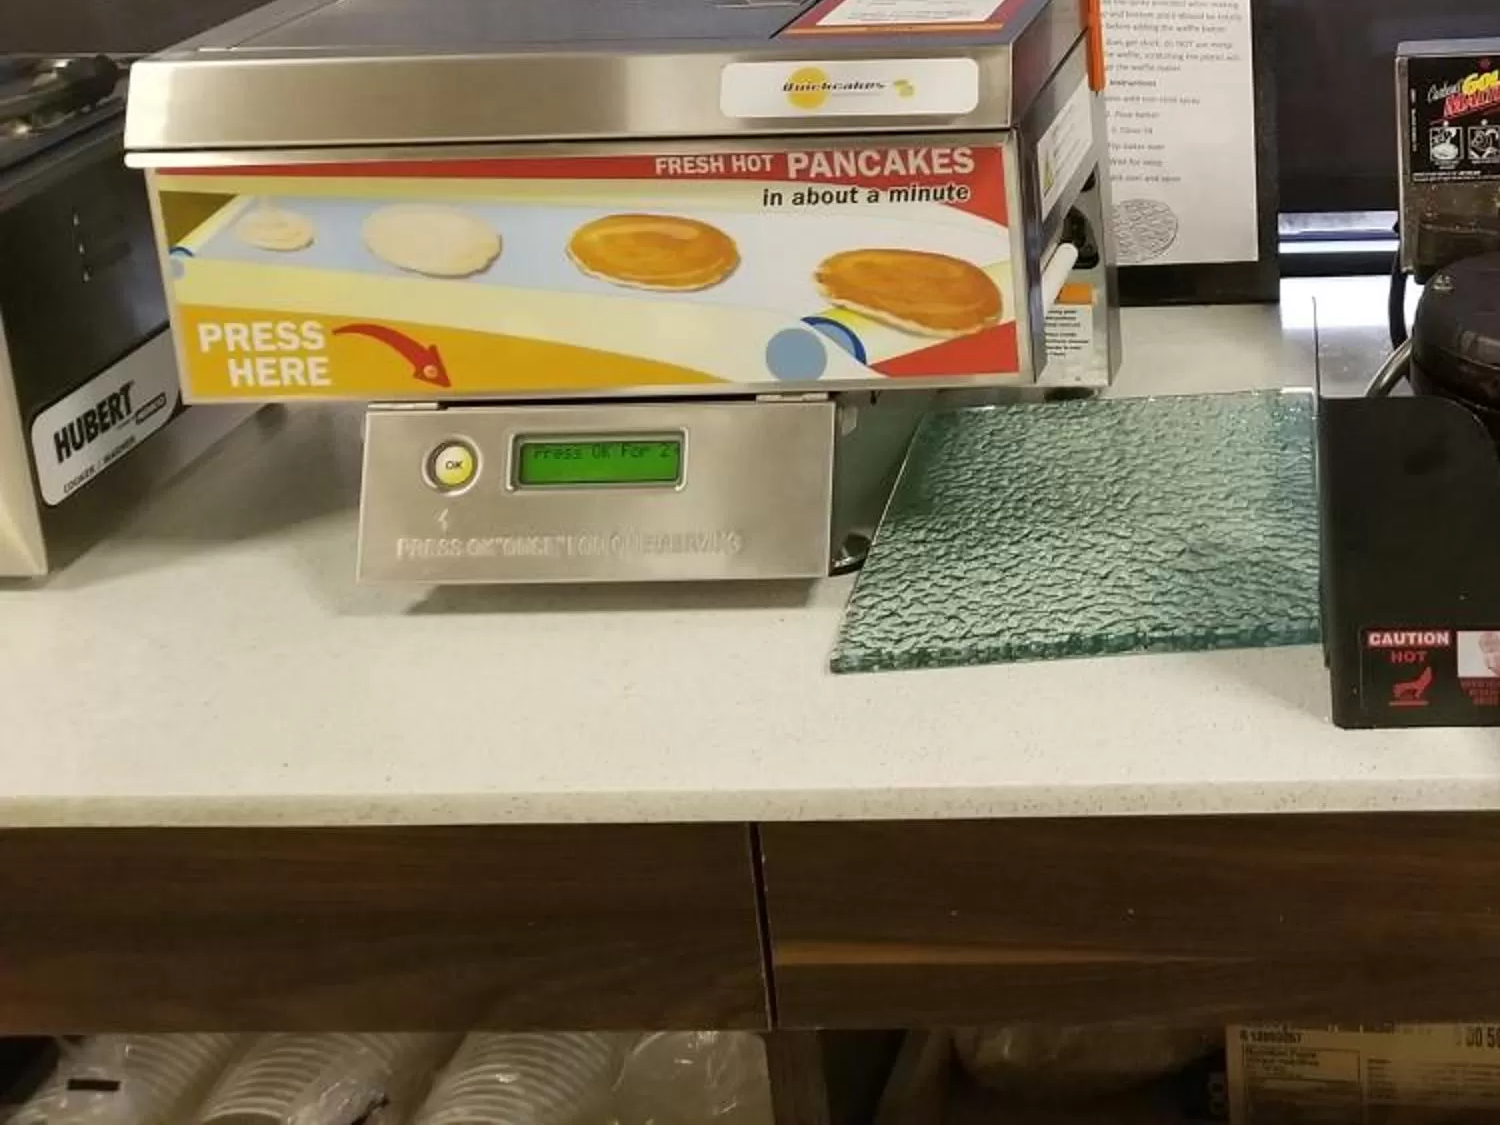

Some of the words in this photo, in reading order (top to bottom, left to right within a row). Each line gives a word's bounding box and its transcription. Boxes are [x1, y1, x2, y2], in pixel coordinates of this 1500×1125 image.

[655, 156, 725, 175] FRESH
[731, 154, 775, 173] HOT
[786, 148, 976, 179] PANCAKES
[763, 188, 783, 207] in
[791, 186, 859, 206] about
[867, 190, 880, 204] a
[889, 183, 970, 203] minute
[198, 320, 326, 353] PRESS
[227, 356, 332, 388] HERE
[53, 379, 135, 464] HUBERT
[445, 460, 463, 470] OK
[1368, 630, 1450, 647] CAUTION
[1391, 651, 1428, 664] HOT
